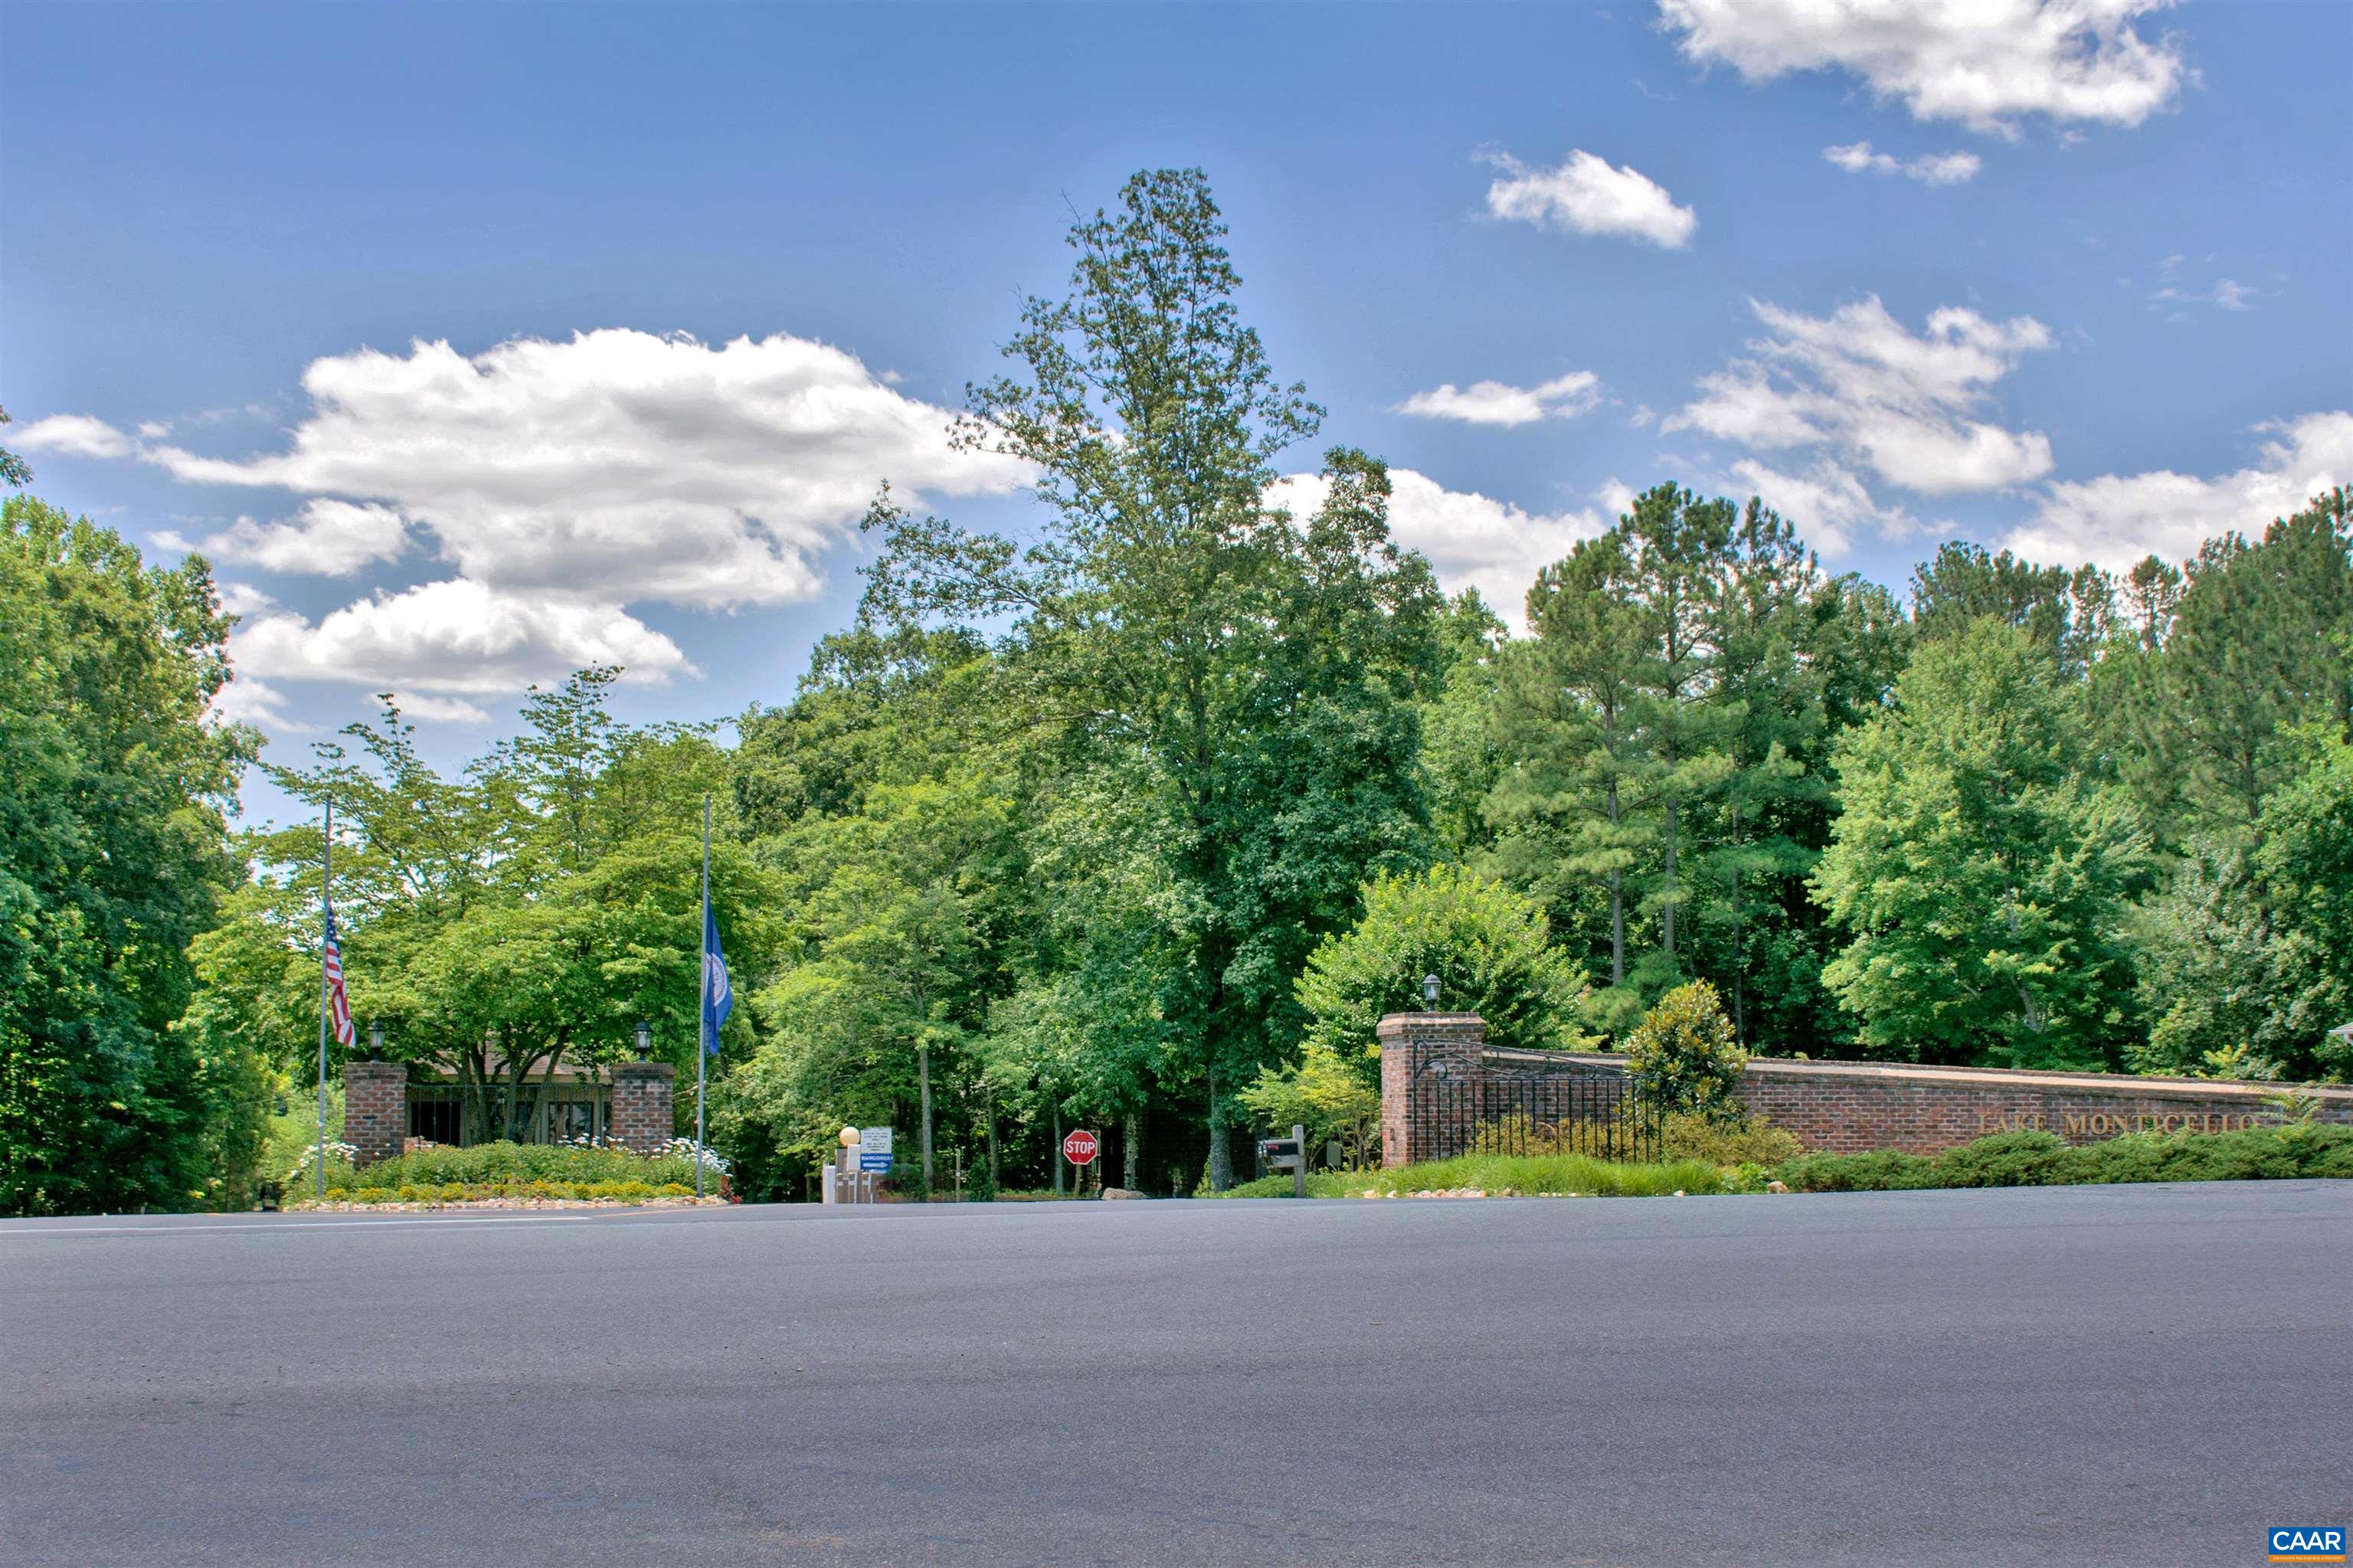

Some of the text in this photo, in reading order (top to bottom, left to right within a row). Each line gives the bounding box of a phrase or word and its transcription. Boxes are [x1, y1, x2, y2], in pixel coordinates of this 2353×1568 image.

[1978, 1113, 2256, 1135] LAKE MONTICELLO
[1066, 1141, 1095, 1154] STOP
